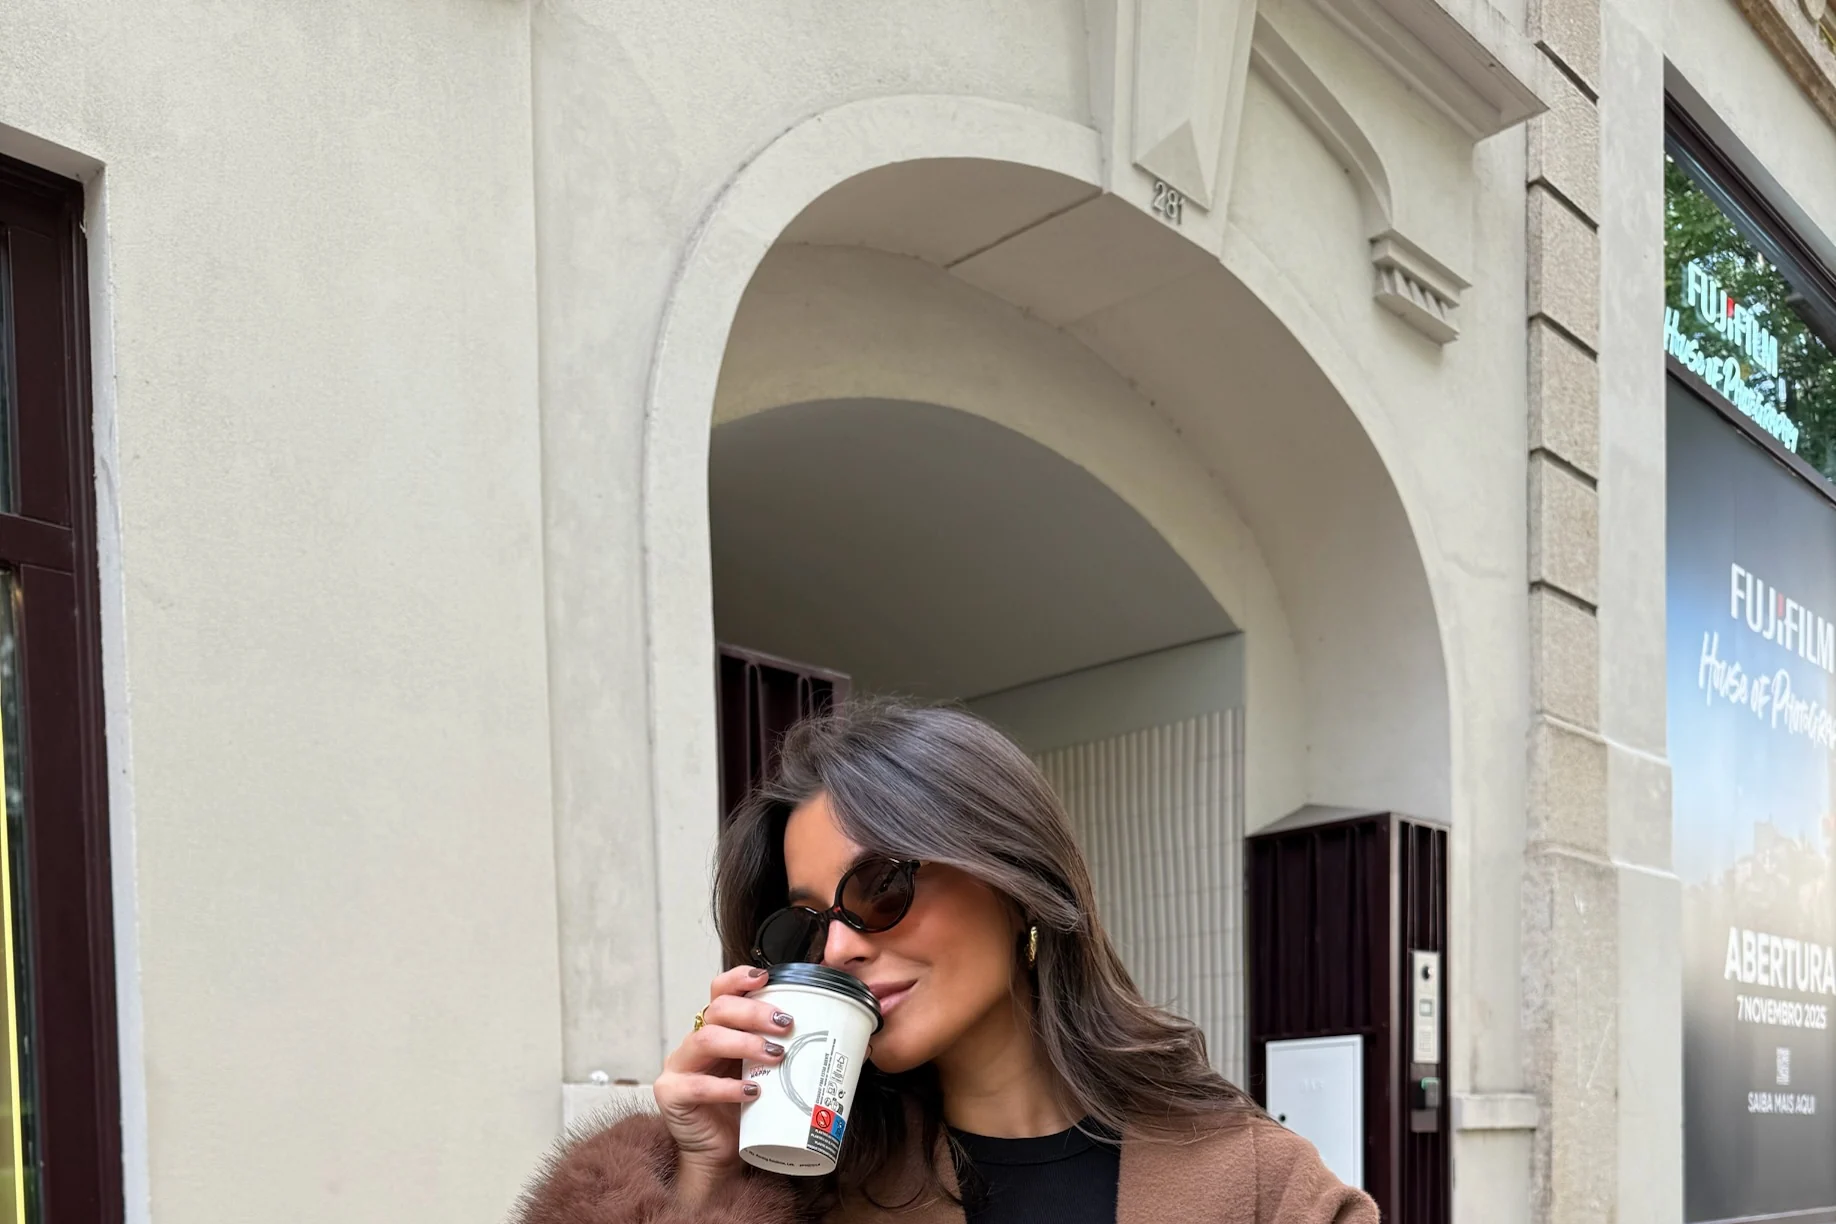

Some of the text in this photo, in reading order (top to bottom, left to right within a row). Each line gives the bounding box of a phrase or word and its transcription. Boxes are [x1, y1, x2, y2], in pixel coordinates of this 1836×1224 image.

[1688, 261, 1778, 378] FUJIFILM
[1731, 562, 1835, 674] FUJIFILM
[1724, 926, 1836, 996] ABERTURA
[1804, 1003, 1827, 1030] 2025
[1748, 1092, 1816, 1116] SAIBA MAIS AQUI
